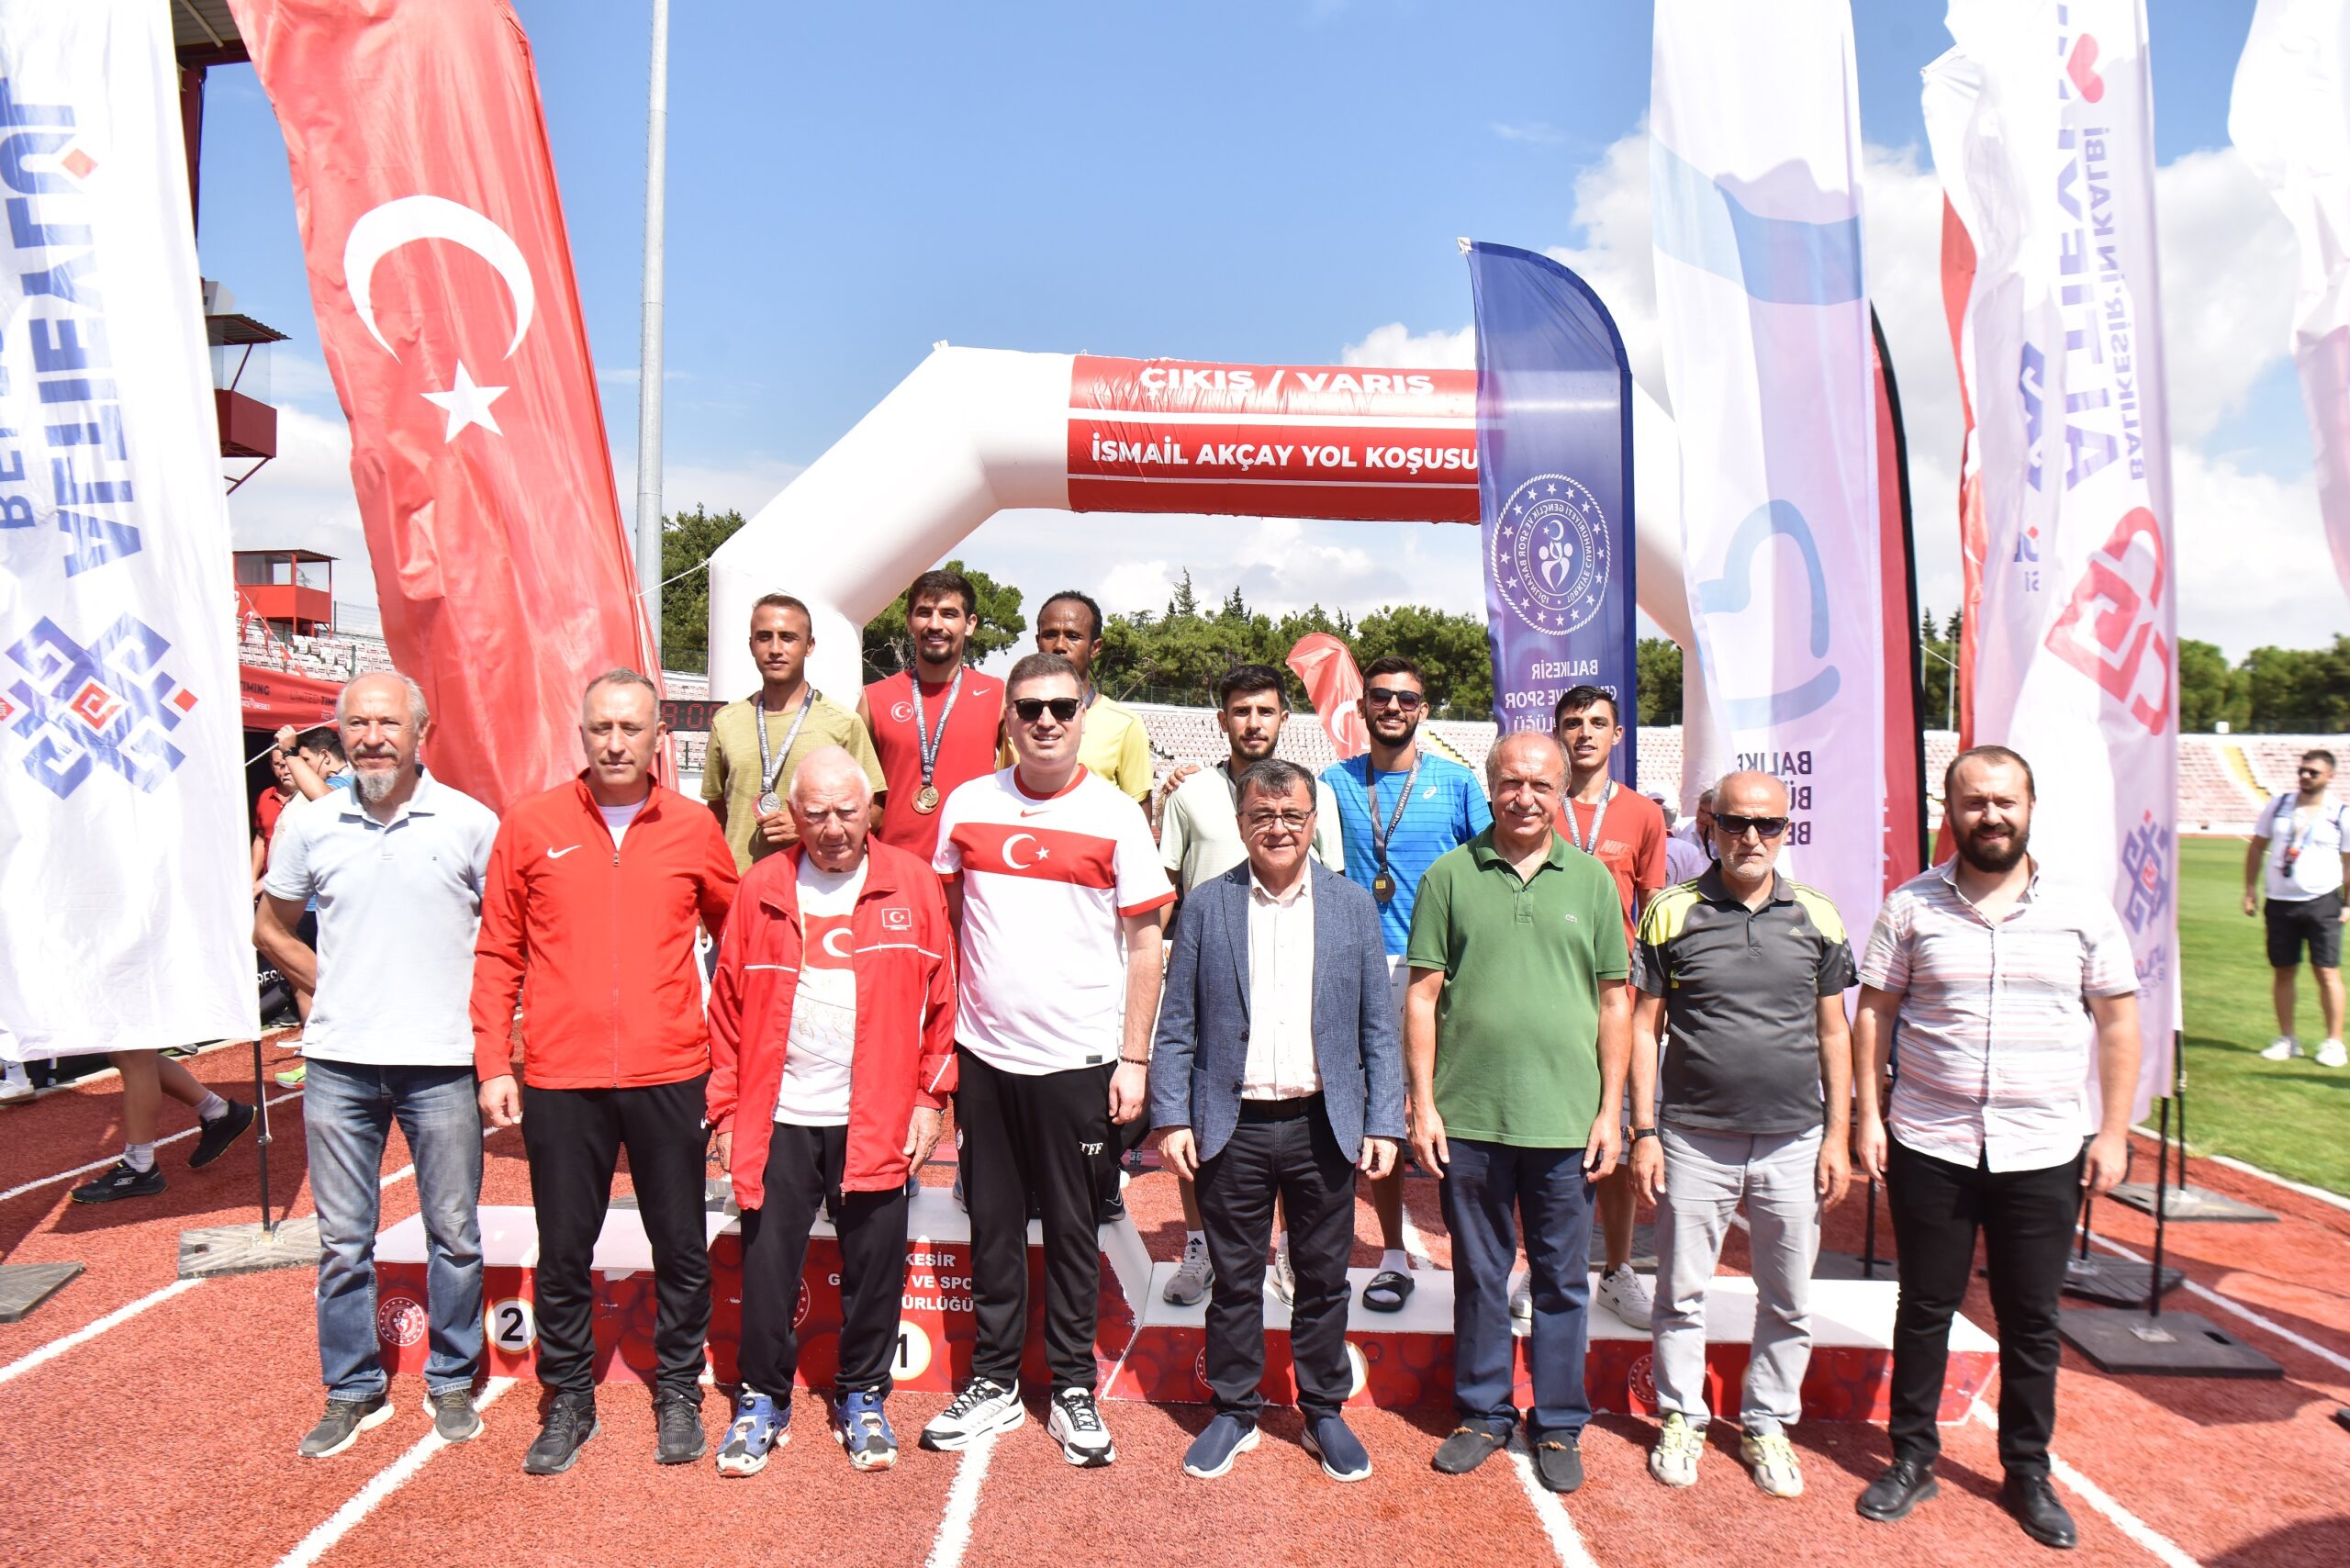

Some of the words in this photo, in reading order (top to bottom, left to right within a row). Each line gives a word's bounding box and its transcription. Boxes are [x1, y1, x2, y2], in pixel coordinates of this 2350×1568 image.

[1140, 367, 1256, 400] ÇIKIŞ
[1091, 431, 1189, 465] İSMAİL
[1196, 443, 1297, 471] AKÇAY
[1301, 445, 1357, 468] YOL
[1365, 447, 1479, 475] KOŞUSU
[1599, 839, 1631, 856] NIKE
[912, 1275, 934, 1289] VE
[901, 1294, 974, 1313] ÜRLÜĞÜ
[500, 1307, 523, 1342] 2
[898, 1333, 908, 1368] 1
